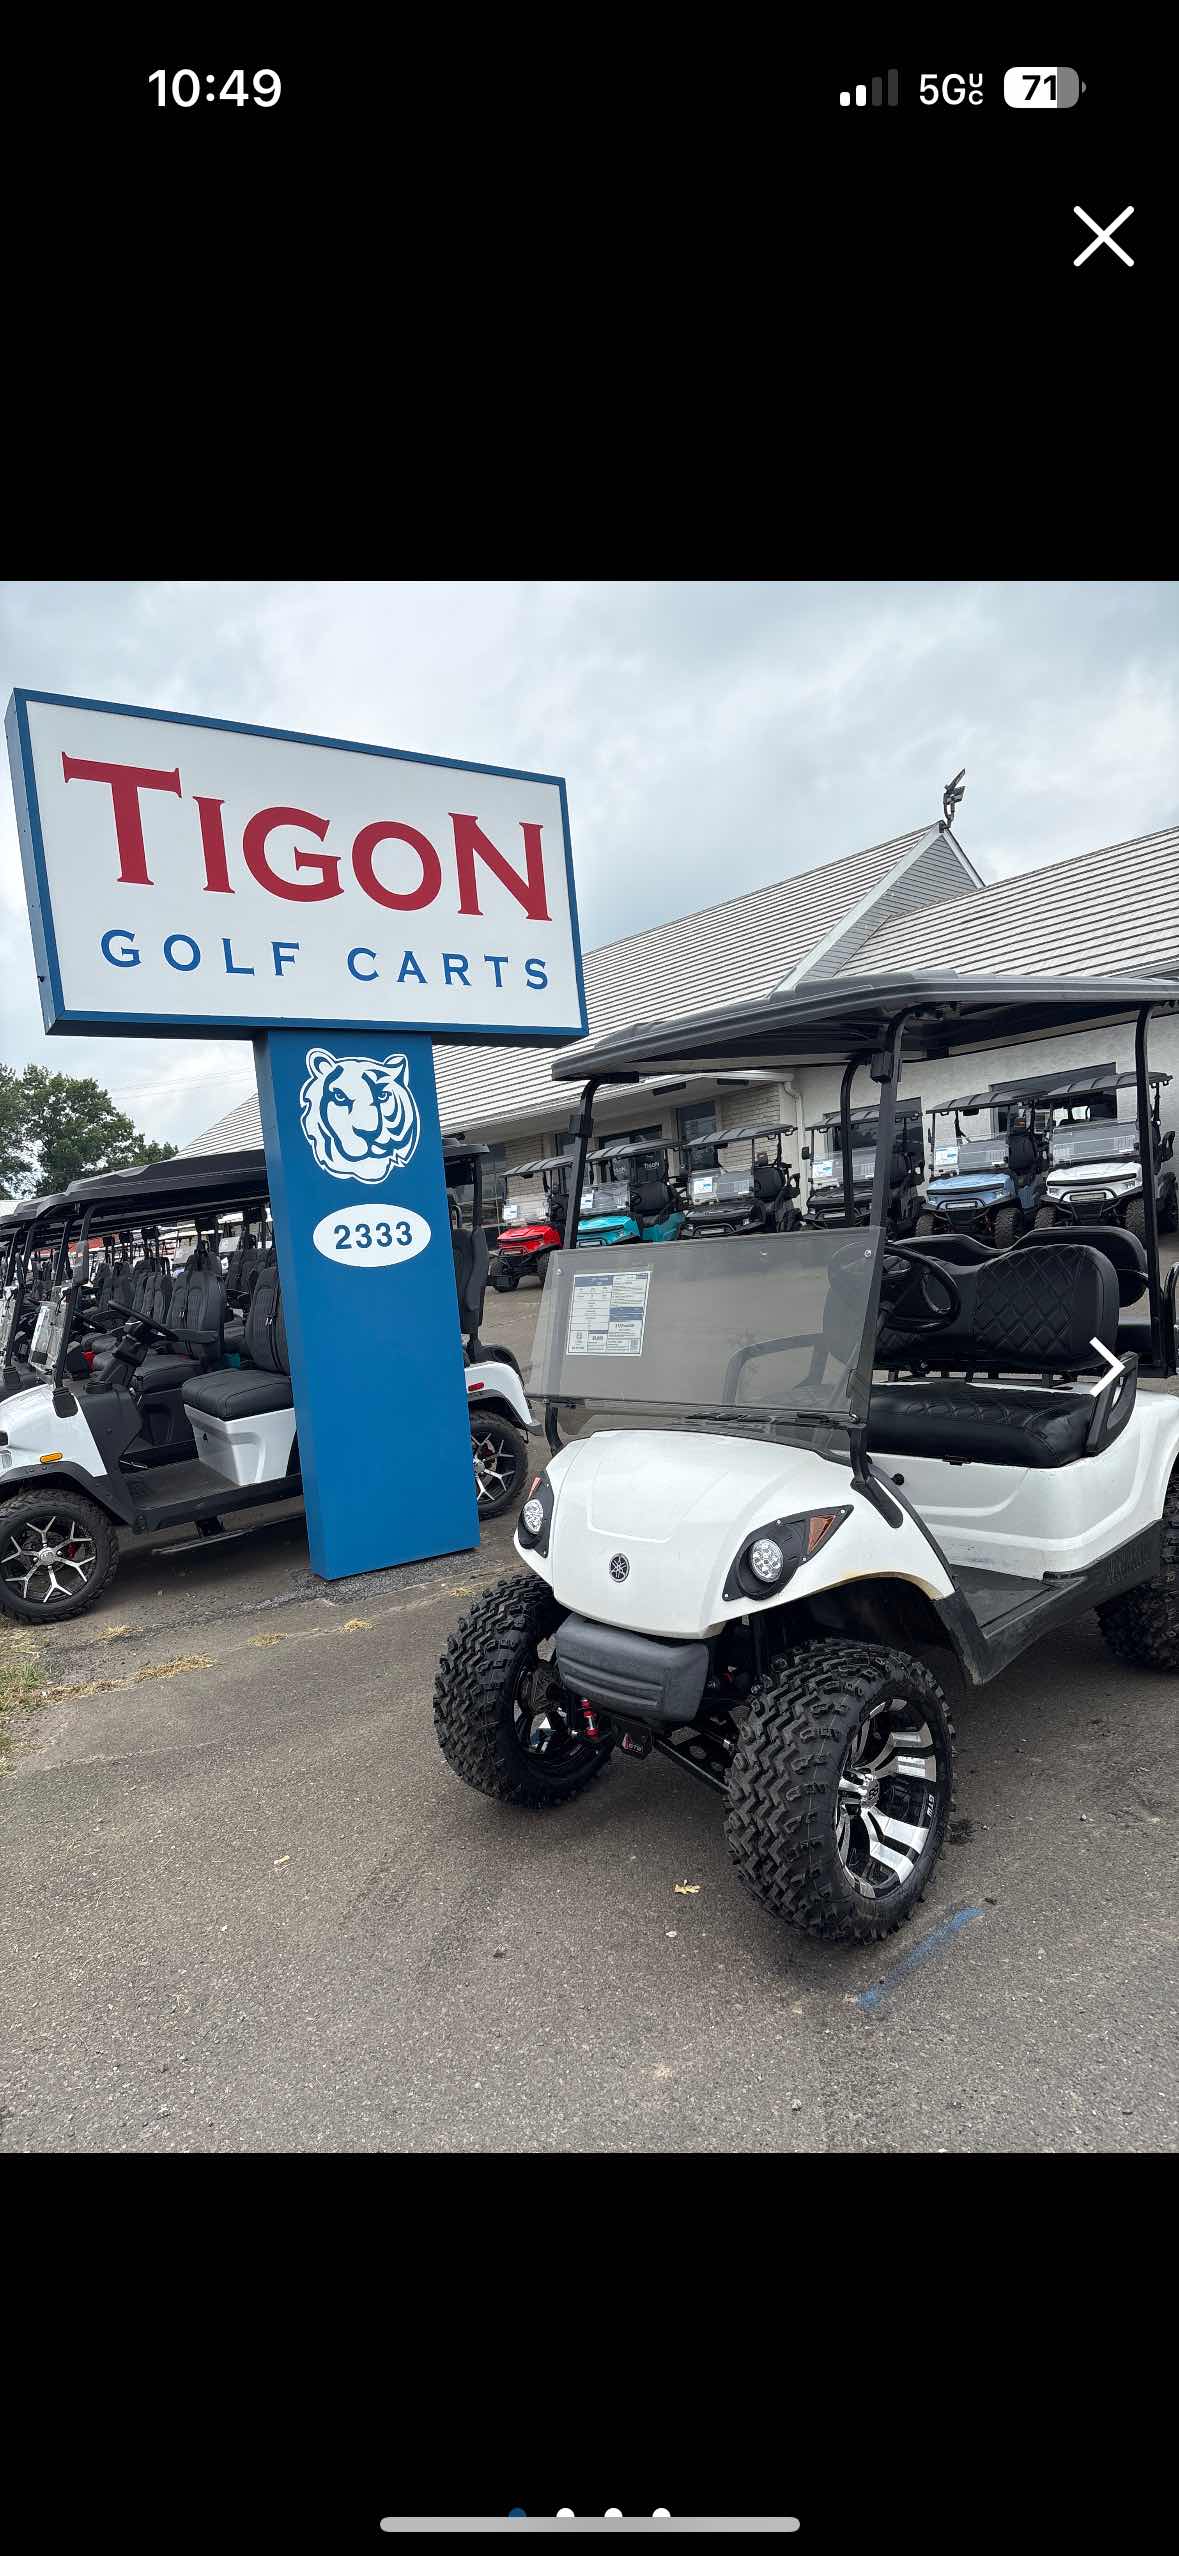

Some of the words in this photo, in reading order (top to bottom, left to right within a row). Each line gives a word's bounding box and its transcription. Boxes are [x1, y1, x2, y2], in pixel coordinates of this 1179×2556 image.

[61, 752, 550, 922] TIGON
[100, 929, 300, 976] GOLF
[346, 946, 550, 991] CARTS
[334, 1221, 413, 1251] 2333
